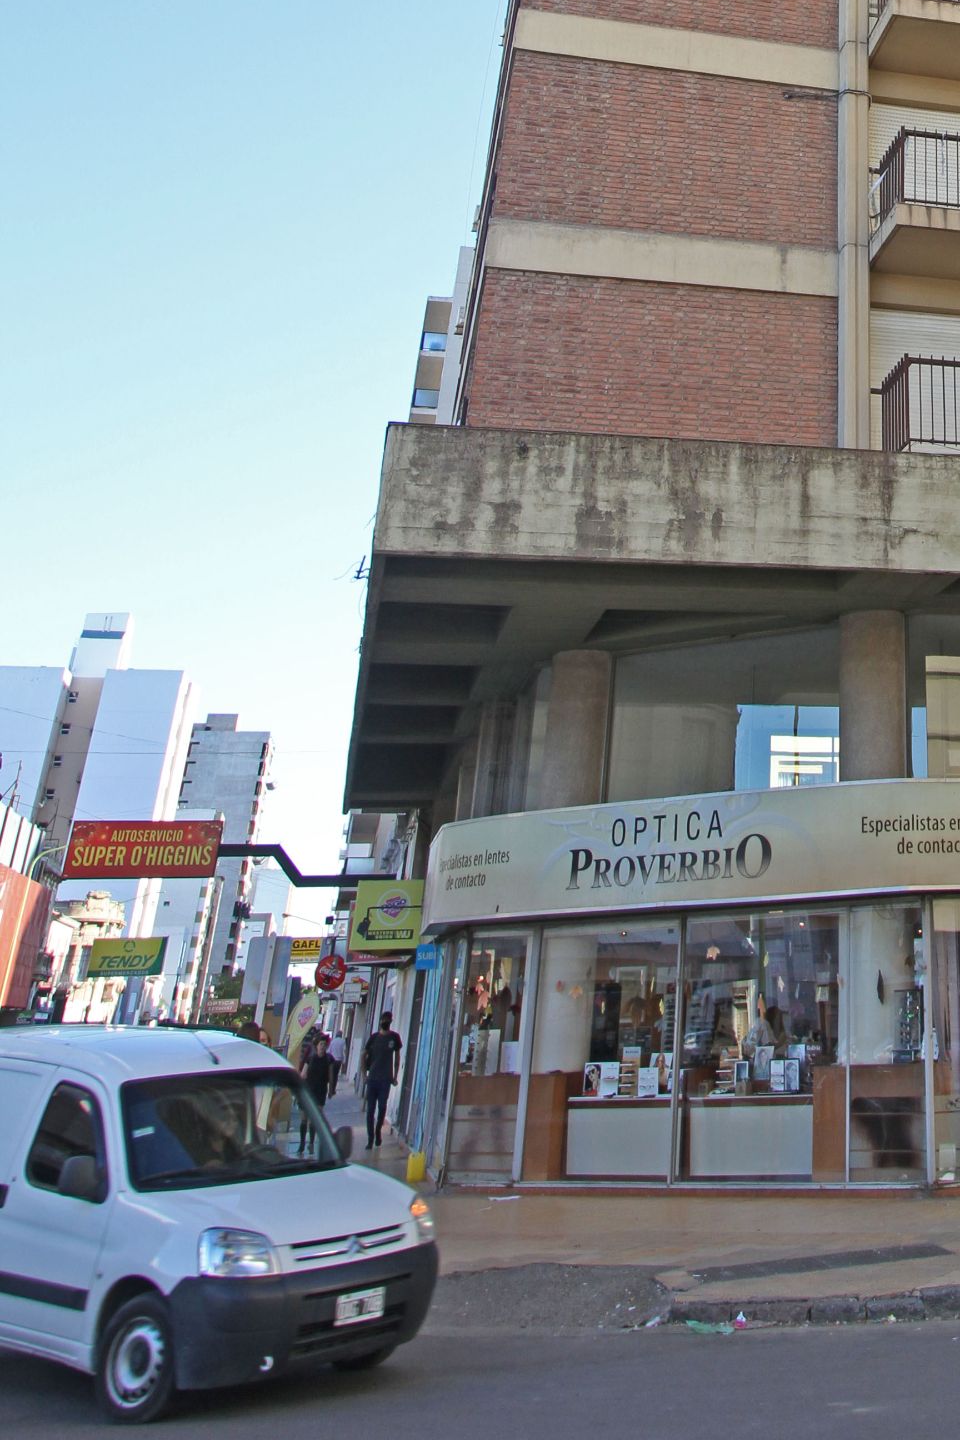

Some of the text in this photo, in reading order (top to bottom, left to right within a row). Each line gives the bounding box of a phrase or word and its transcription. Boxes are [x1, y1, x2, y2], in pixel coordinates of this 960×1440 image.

[610, 809, 723, 847] OPTICA
[861, 813, 946, 837] Especialistas
[110, 829, 185, 843] AUTOSERVICIO
[897, 836, 914, 855] de
[71, 844, 213, 867] SUPER O'HIGGINS
[473, 853, 483, 866] en
[484, 849, 510, 866] lentes
[565, 833, 773, 891] PROVERBIO
[454, 872, 487, 890] contacto
[98, 954, 155, 968] TENDY
